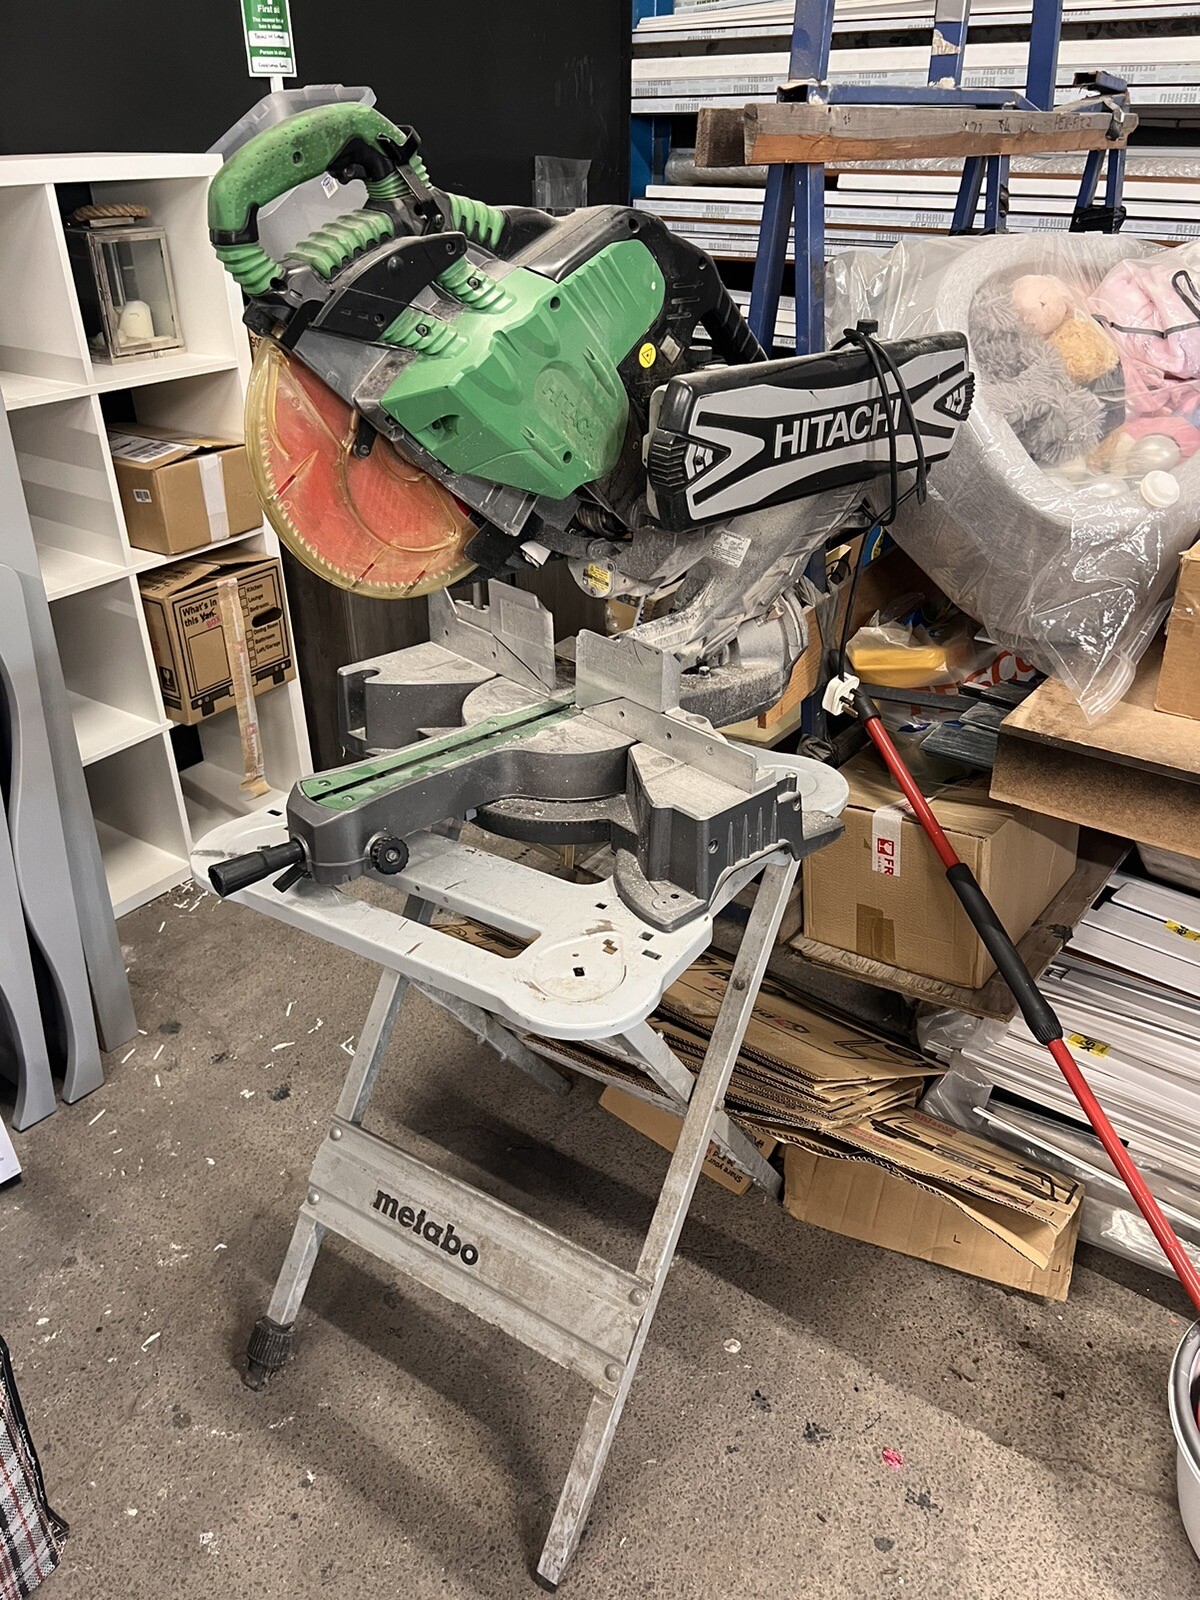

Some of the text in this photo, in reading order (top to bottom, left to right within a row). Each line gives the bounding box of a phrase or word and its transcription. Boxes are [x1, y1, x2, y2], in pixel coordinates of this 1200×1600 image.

[257, 4, 273, 14] First
[705, 204, 730, 213] REHAU
[915, 212, 945, 222] REHAU
[774, 398, 902, 459] HITACHI
[246, 583, 263, 593] Kitchen
[248, 593, 264, 604] Lounge
[182, 603, 209, 617] What's
[184, 615, 199, 628] this
[253, 625, 267, 636] Dining
[254, 632, 276, 645] Bathroom
[708, 1158, 724, 1169] your
[723, 1166, 742, 1182] Share
[372, 1189, 479, 1266] metabo
